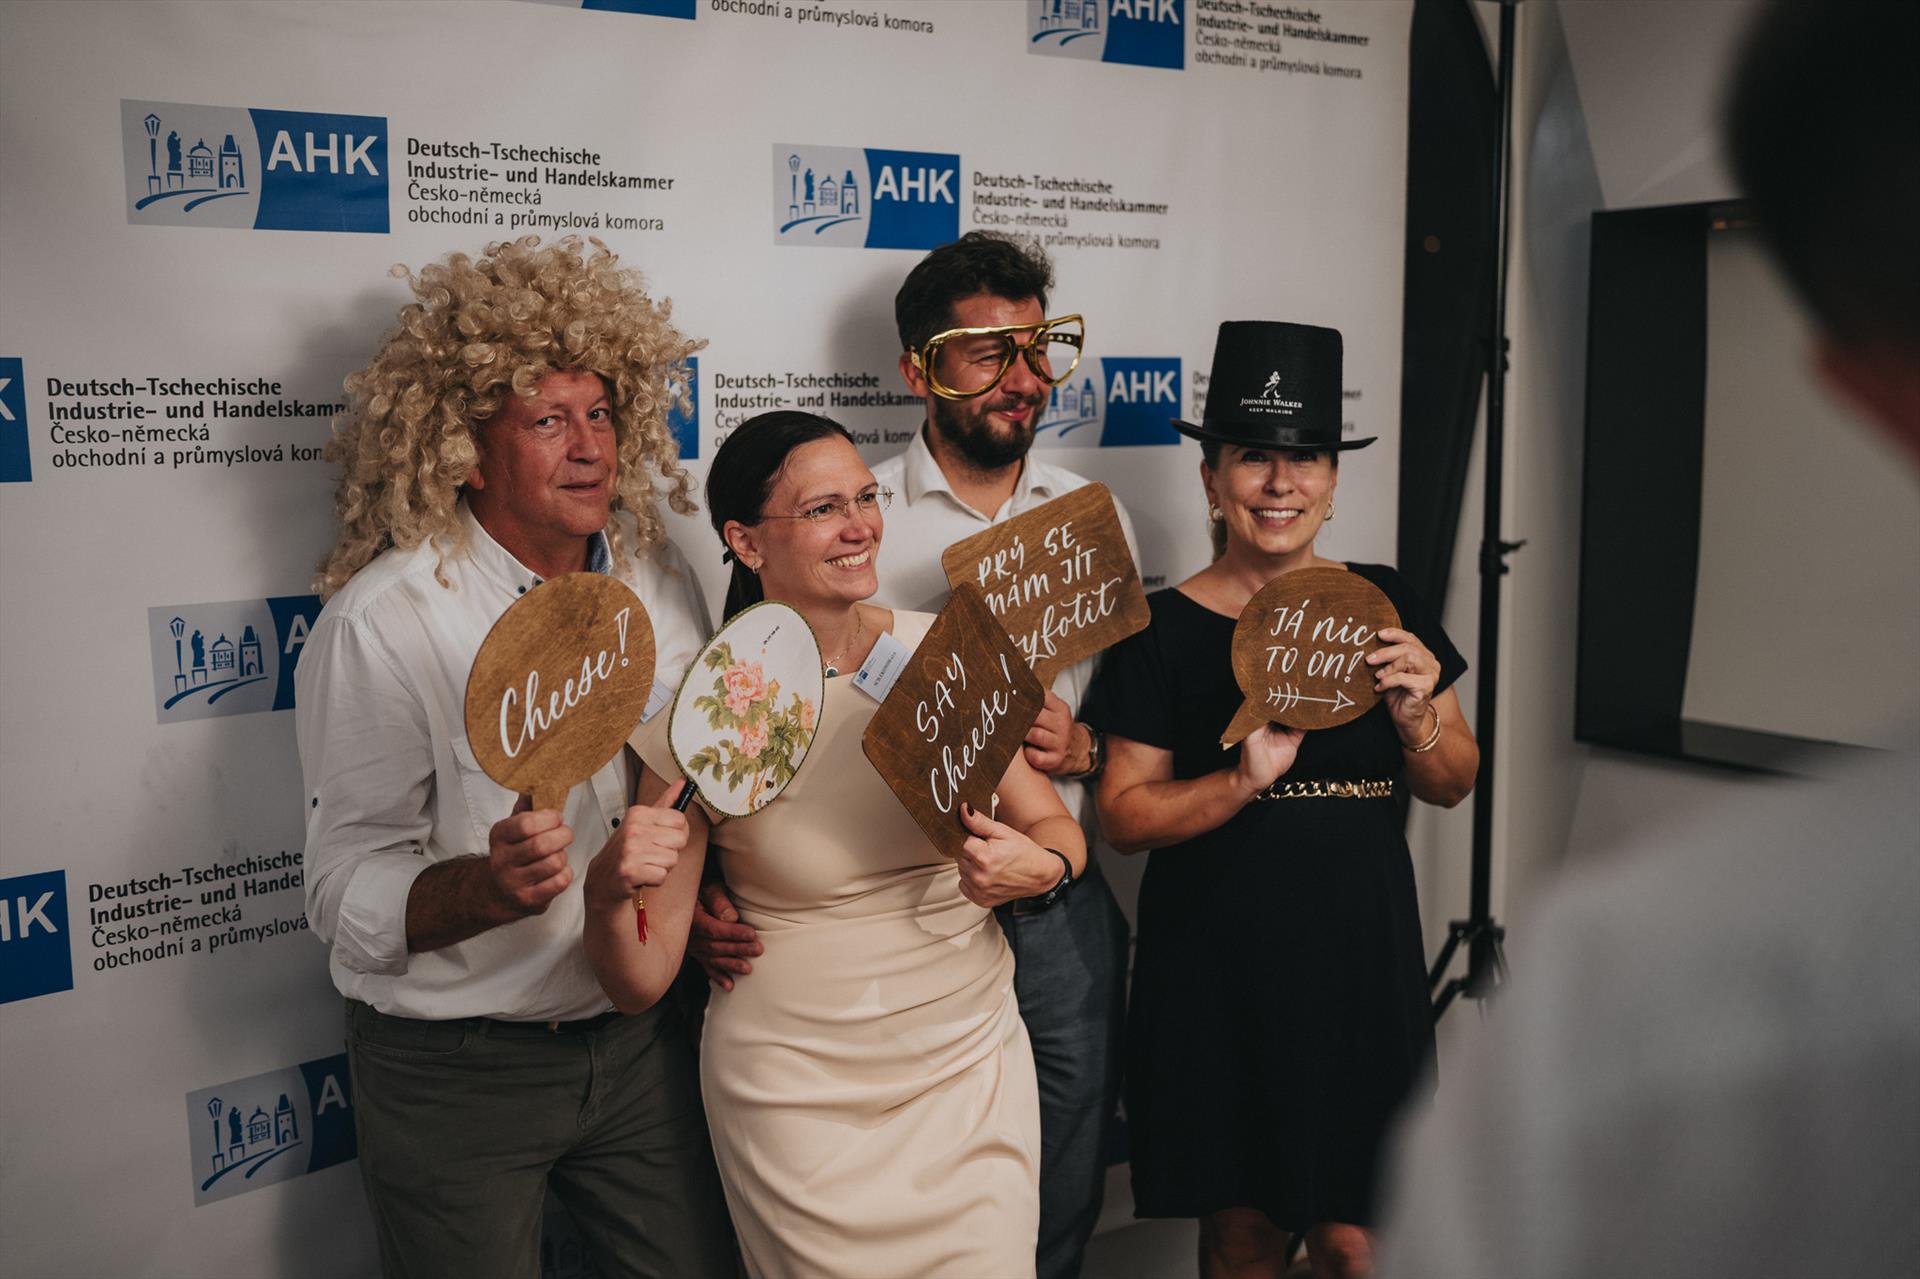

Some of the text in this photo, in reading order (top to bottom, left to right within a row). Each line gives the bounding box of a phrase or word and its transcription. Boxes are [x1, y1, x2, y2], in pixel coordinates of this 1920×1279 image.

[712, 0, 934, 33] obchodní a průmyslová komora
[1111, 0, 1179, 25] AHK
[1195, 28, 1281, 52] Česko-německá
[1196, 13, 1370, 46] Industrie- und Handelskammer
[1195, 51, 1362, 79] obchodní a průmyslová komora
[267, 129, 379, 176] AHK
[407, 138, 601, 165] Deutsch-Tschechische
[408, 160, 675, 190] Industrie- und Handelskammer
[874, 165, 954, 204] AHK
[973, 171, 1113, 194] Deutsch-Tschechische
[408, 178, 542, 206] Česko-německá
[972, 190, 1169, 215] Industrie- und Handelskammer
[408, 205, 664, 231] obchodní a průmyslová komora
[972, 206, 1068, 228] Česko-německá
[1044, 231, 1113, 248] průmyslová
[1118, 233, 1161, 249] komora
[47, 377, 282, 397] Deutsch-Tschechische
[715, 373, 880, 389] Deutsch-Tschechische
[1108, 370, 1176, 403] AHK
[49, 401, 157, 420] Industrie-
[166, 400, 204, 418] und
[715, 393, 791, 408] Industrie-
[797, 392, 824, 407] und
[1240, 398, 1302, 408] JOHNNIE WALKER
[50, 422, 210, 444] Česko-německá
[52, 447, 146, 468] obchodní
[154, 450, 164, 465] a
[173, 444, 283, 469] průmyslová
[1044, 521, 1076, 556] SE
[1061, 545, 1097, 585] JÍT
[1270, 599, 1310, 640] JÁ
[1266, 646, 1299, 674] TO
[500, 607, 630, 758] Cheese!
[917, 652, 966, 742] SAY
[931, 653, 1017, 813] Cheese!
[89, 850, 304, 902] Deutsch-Tschechische
[90, 896, 193, 925] Industrie-
[201, 882, 236, 905] und
[92, 904, 242, 948] Česko-německá
[93, 911, 309, 972] obchodní a průmyslová
